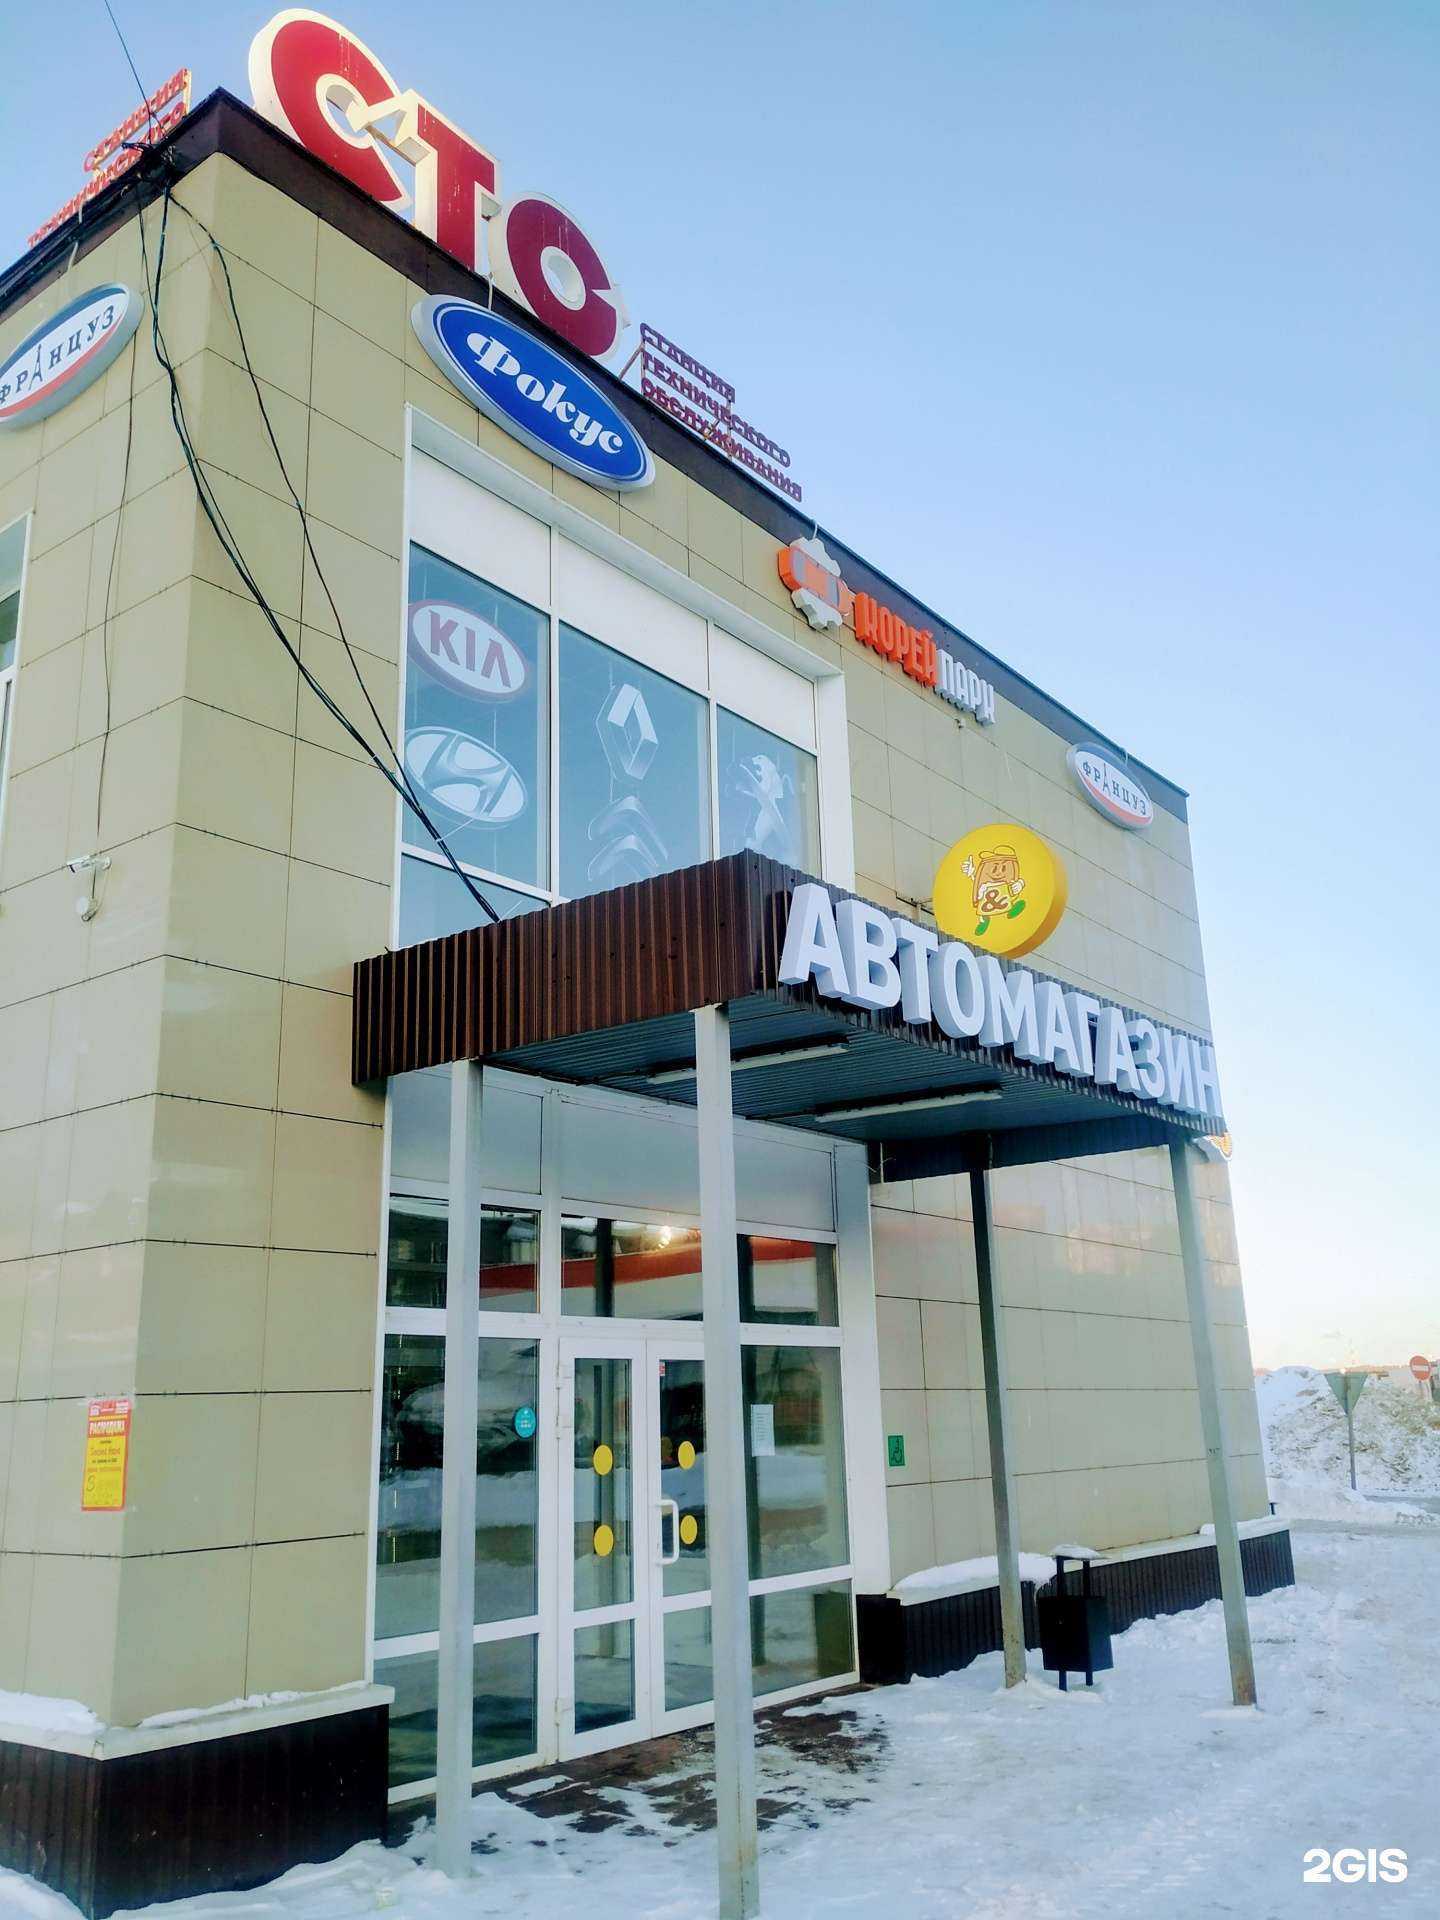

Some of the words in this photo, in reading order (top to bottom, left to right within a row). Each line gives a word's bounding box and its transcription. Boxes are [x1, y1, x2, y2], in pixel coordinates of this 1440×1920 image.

[466, 332, 624, 454] Фокус
[640, 322, 736, 404] СТАНЦИЯ
[642, 349, 791, 468] ТЕХНИЧЕСКОГО
[1082, 761, 1146, 816] ФРАНЦУЗ
[779, 882, 1223, 1118] АВТОМАГАЗИН
